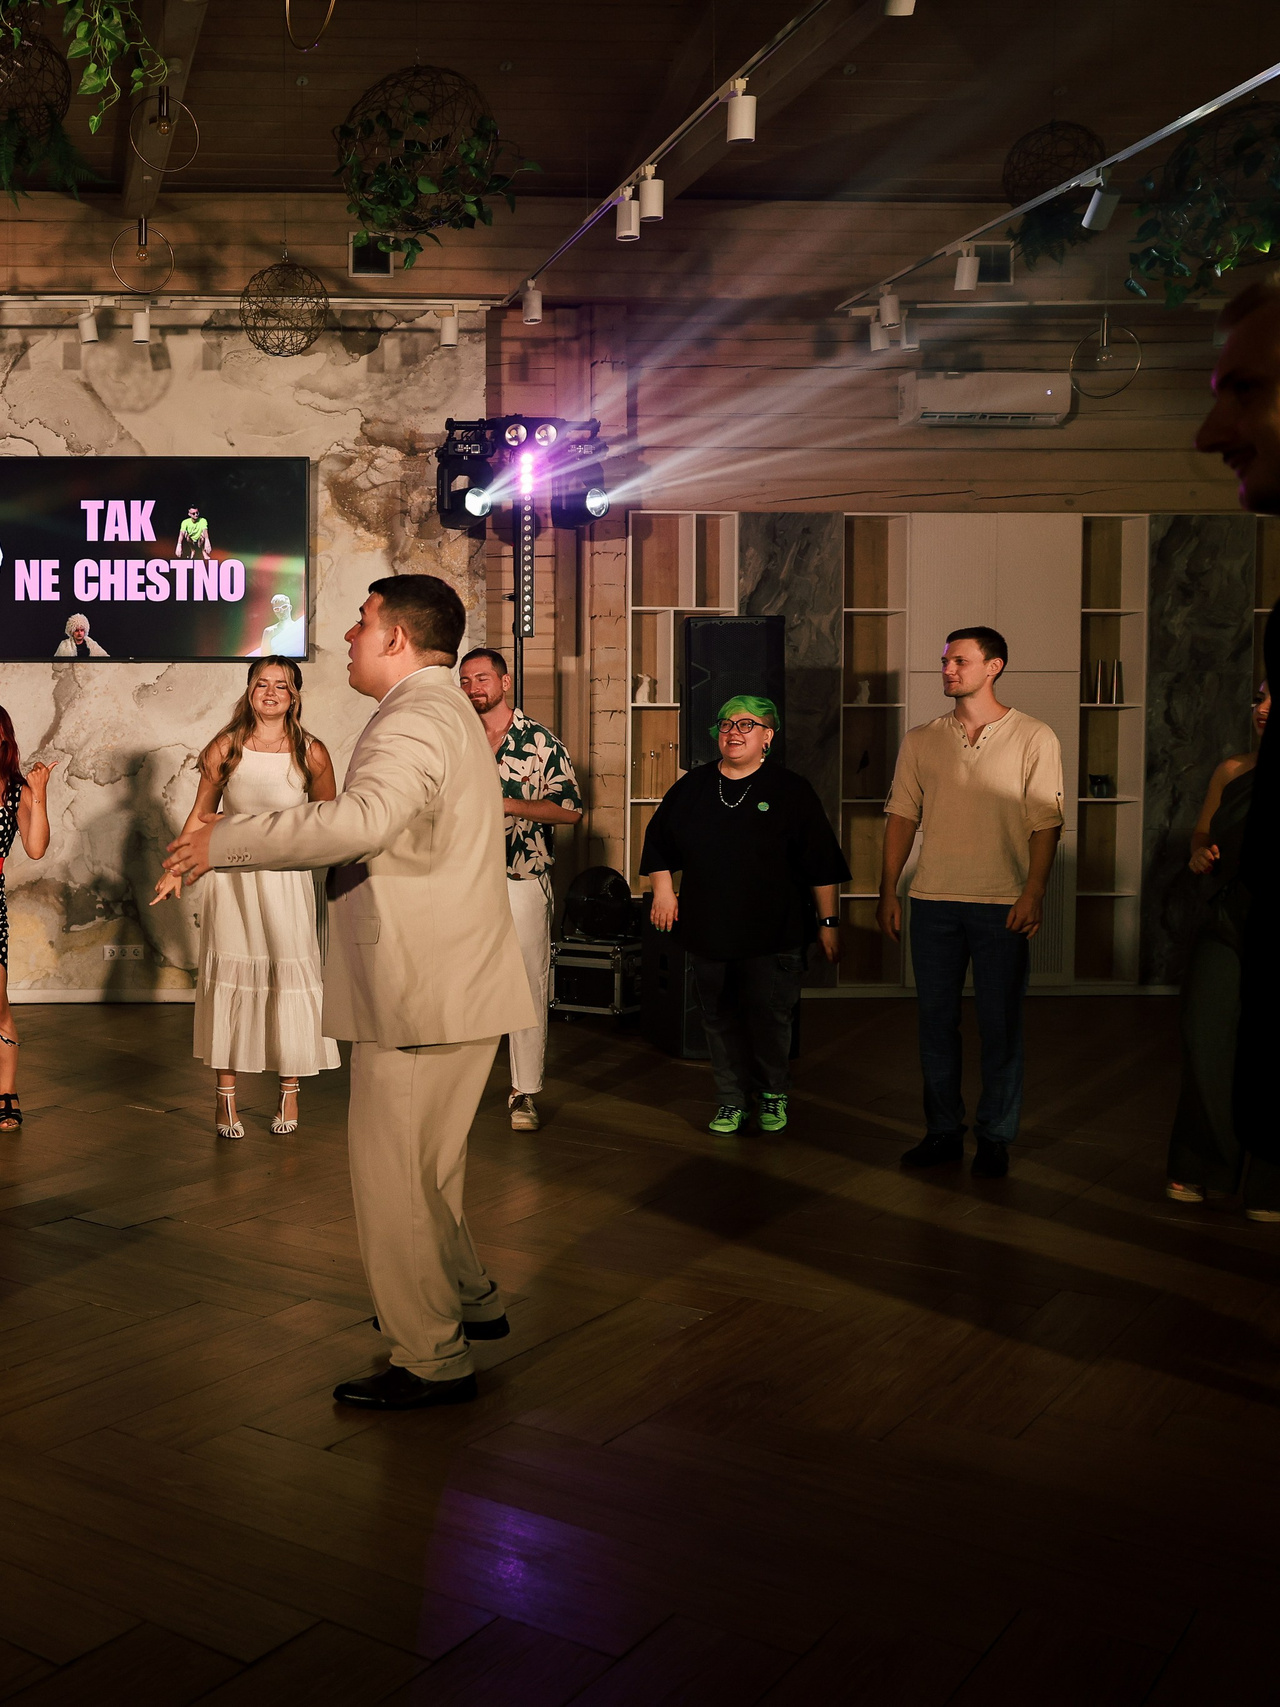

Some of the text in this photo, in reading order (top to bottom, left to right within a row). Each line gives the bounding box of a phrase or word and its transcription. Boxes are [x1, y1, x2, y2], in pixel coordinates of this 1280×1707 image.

[80, 500, 157, 542] TAK
[15, 558, 246, 602] NE CHESTNO
